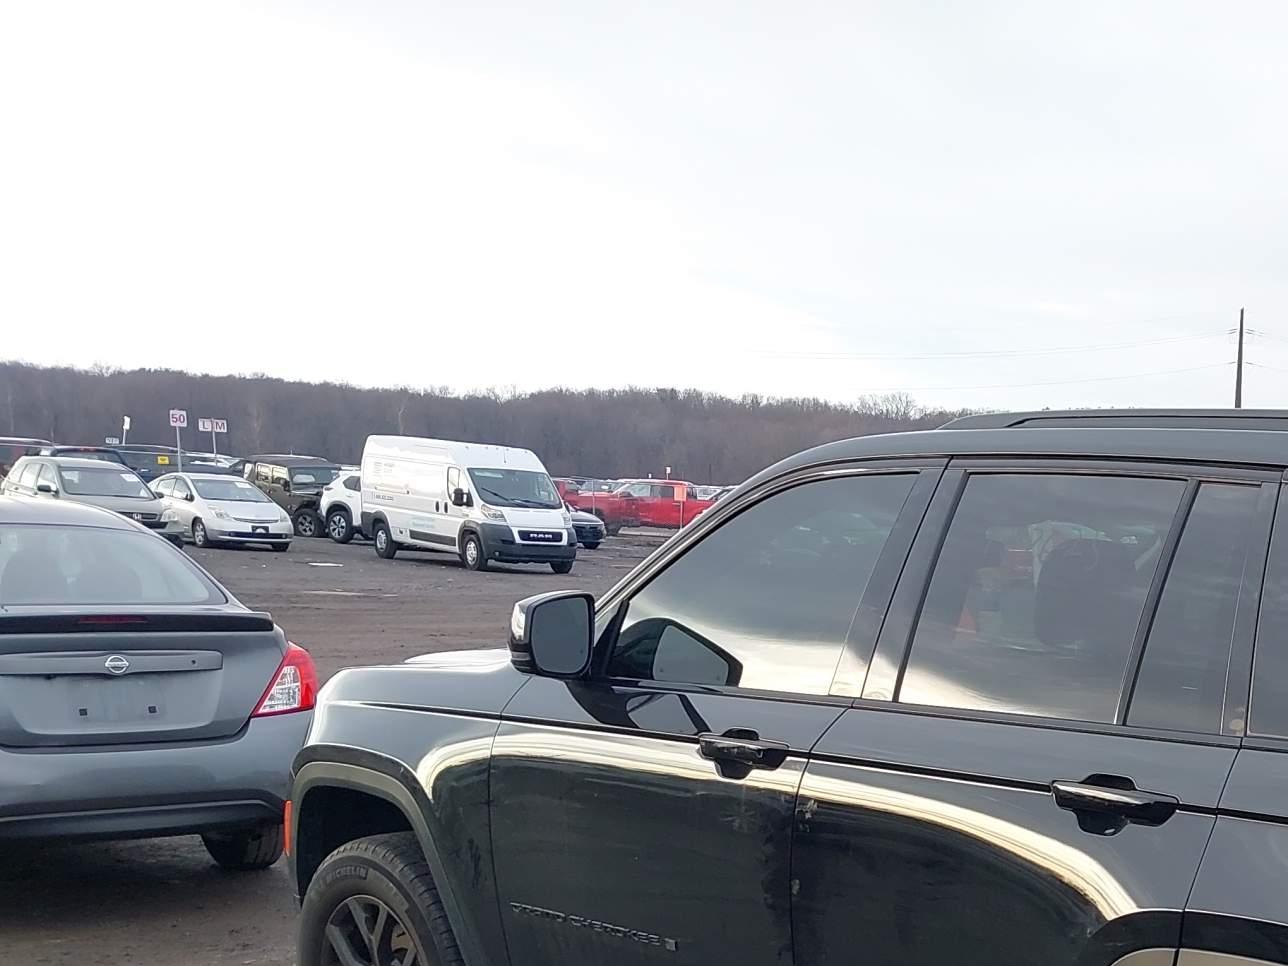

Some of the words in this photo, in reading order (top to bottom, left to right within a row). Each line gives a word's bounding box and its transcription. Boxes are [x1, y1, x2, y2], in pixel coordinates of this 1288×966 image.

[171, 413, 185, 424] 50
[202, 421, 209, 430] L
[215, 421, 225, 431] M
